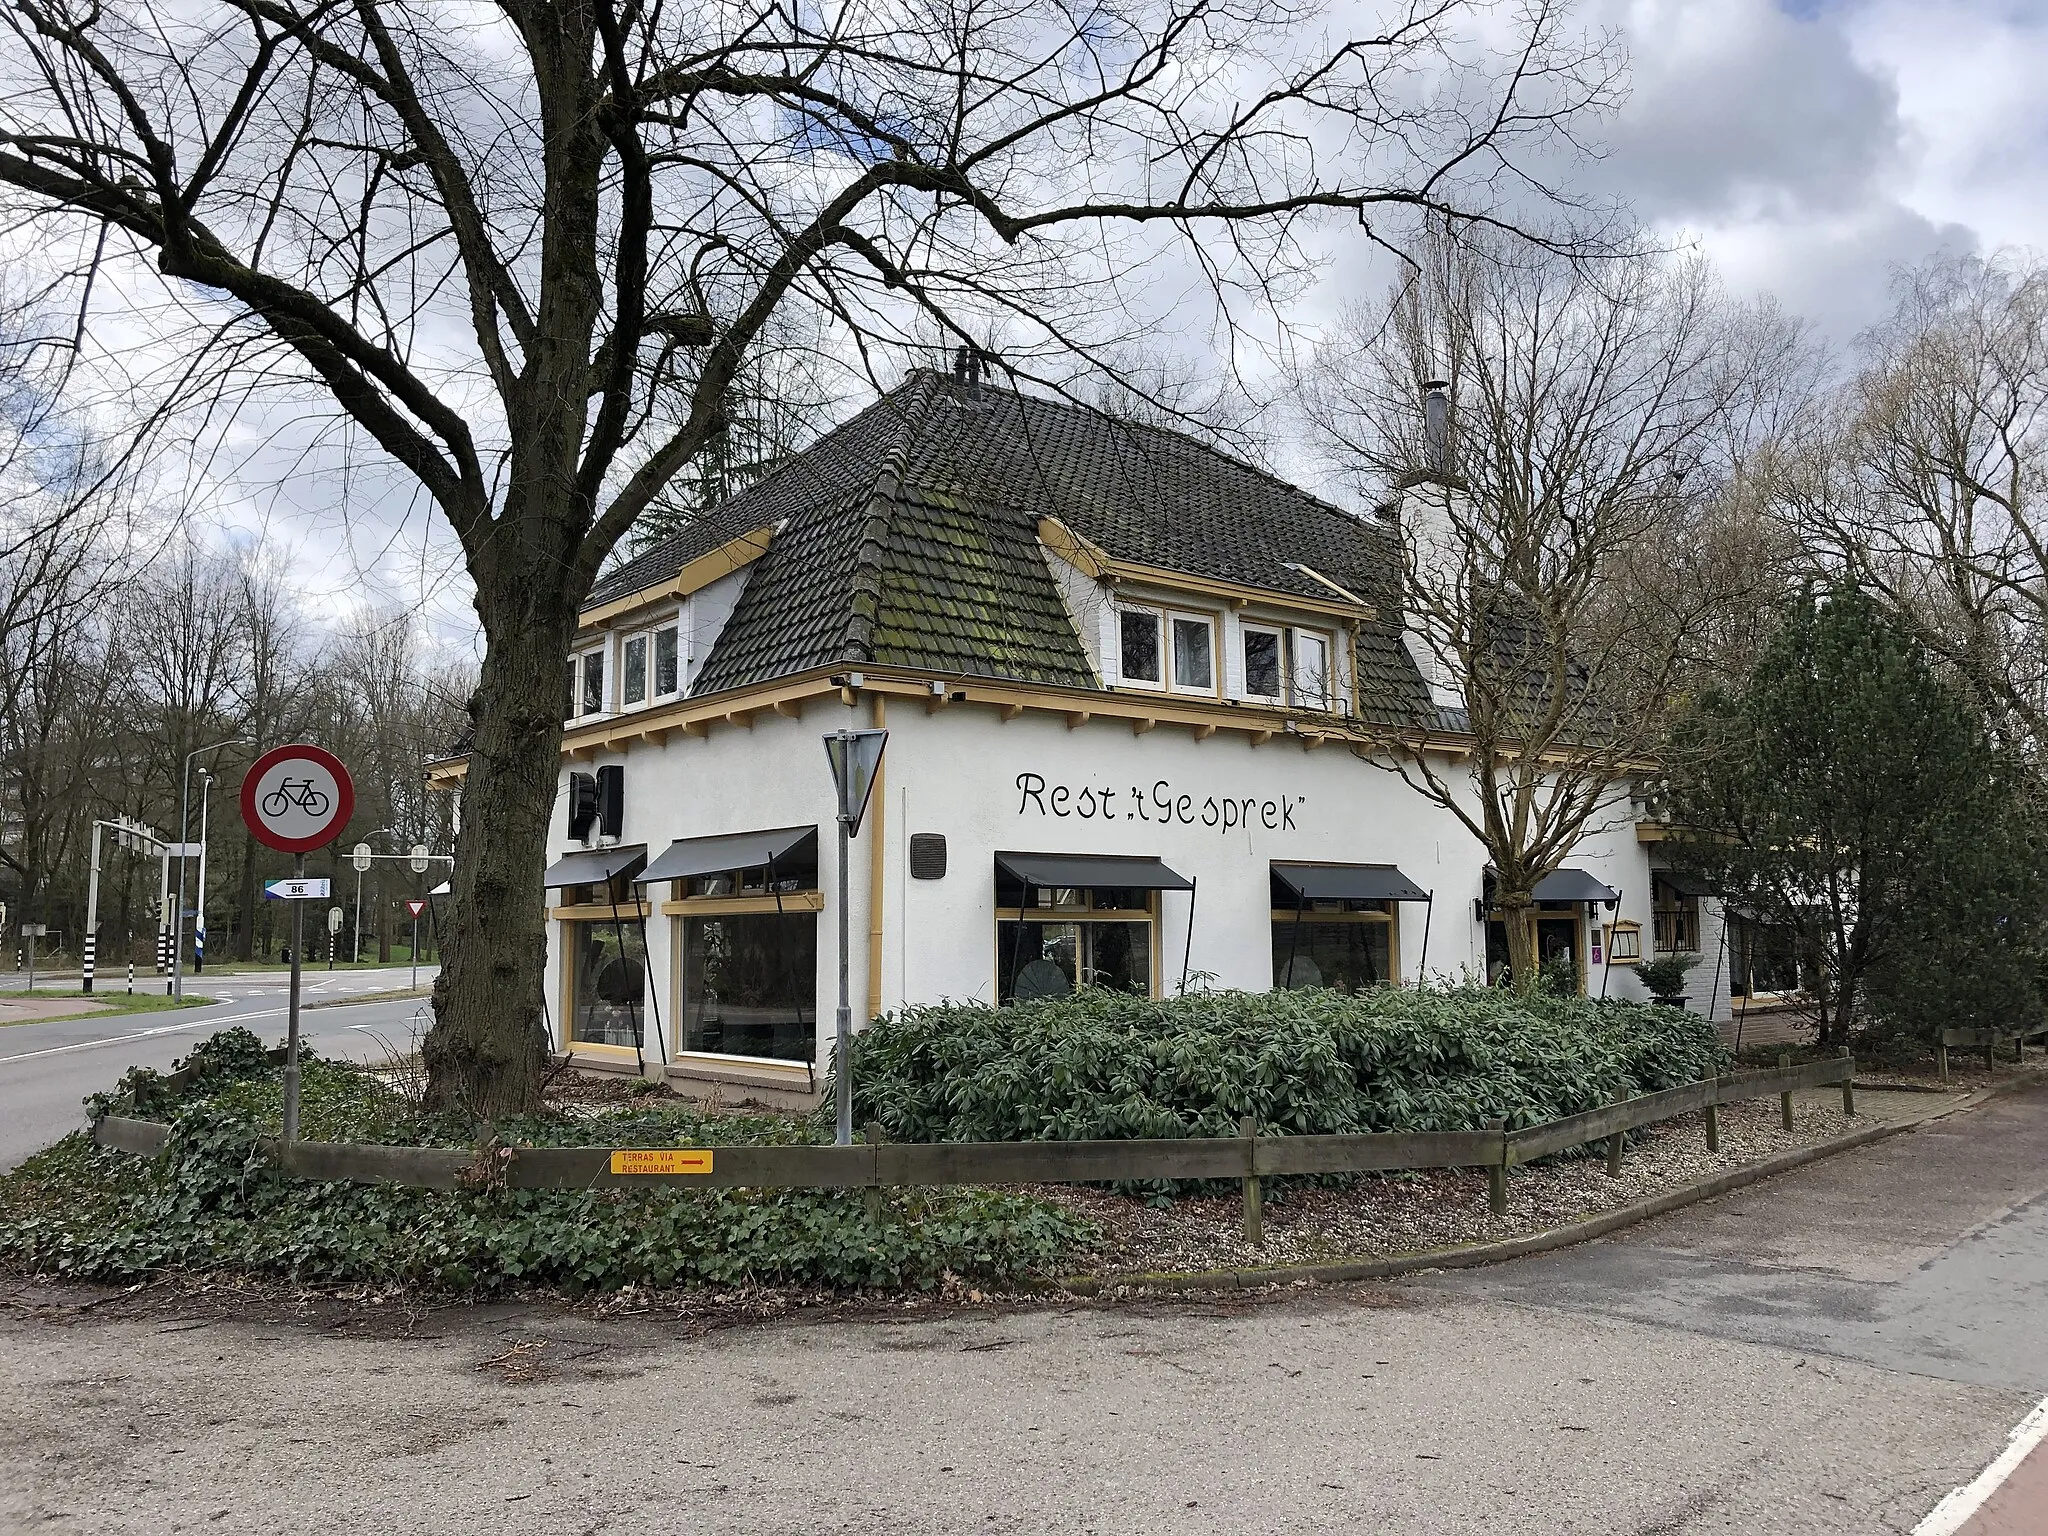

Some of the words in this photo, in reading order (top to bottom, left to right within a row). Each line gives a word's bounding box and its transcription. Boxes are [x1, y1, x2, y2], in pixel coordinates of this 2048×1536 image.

[1016, 772, 1116, 820] Rest
[291, 885, 304, 893] 86
[622, 1152, 654, 1162] TERRAS
[659, 1152, 674, 1161] VIA
[622, 1164, 675, 1173] RESTAURANT
